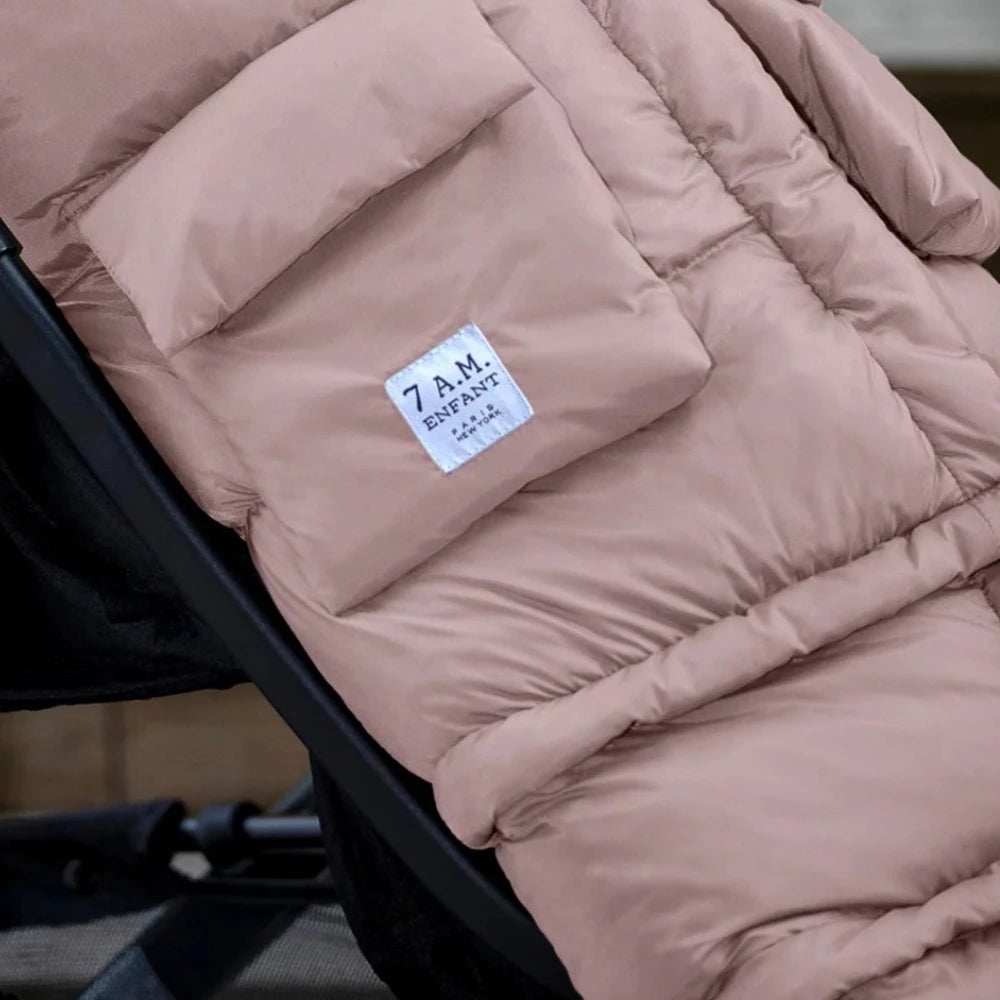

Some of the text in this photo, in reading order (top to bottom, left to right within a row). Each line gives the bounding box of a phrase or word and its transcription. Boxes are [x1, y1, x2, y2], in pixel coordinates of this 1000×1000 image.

[403, 353, 490, 412] 7 A.M.
[422, 372, 500, 431] ENFANT
[451, 404, 494, 435] PARIS
[456, 410, 501, 441] NEW YORK
